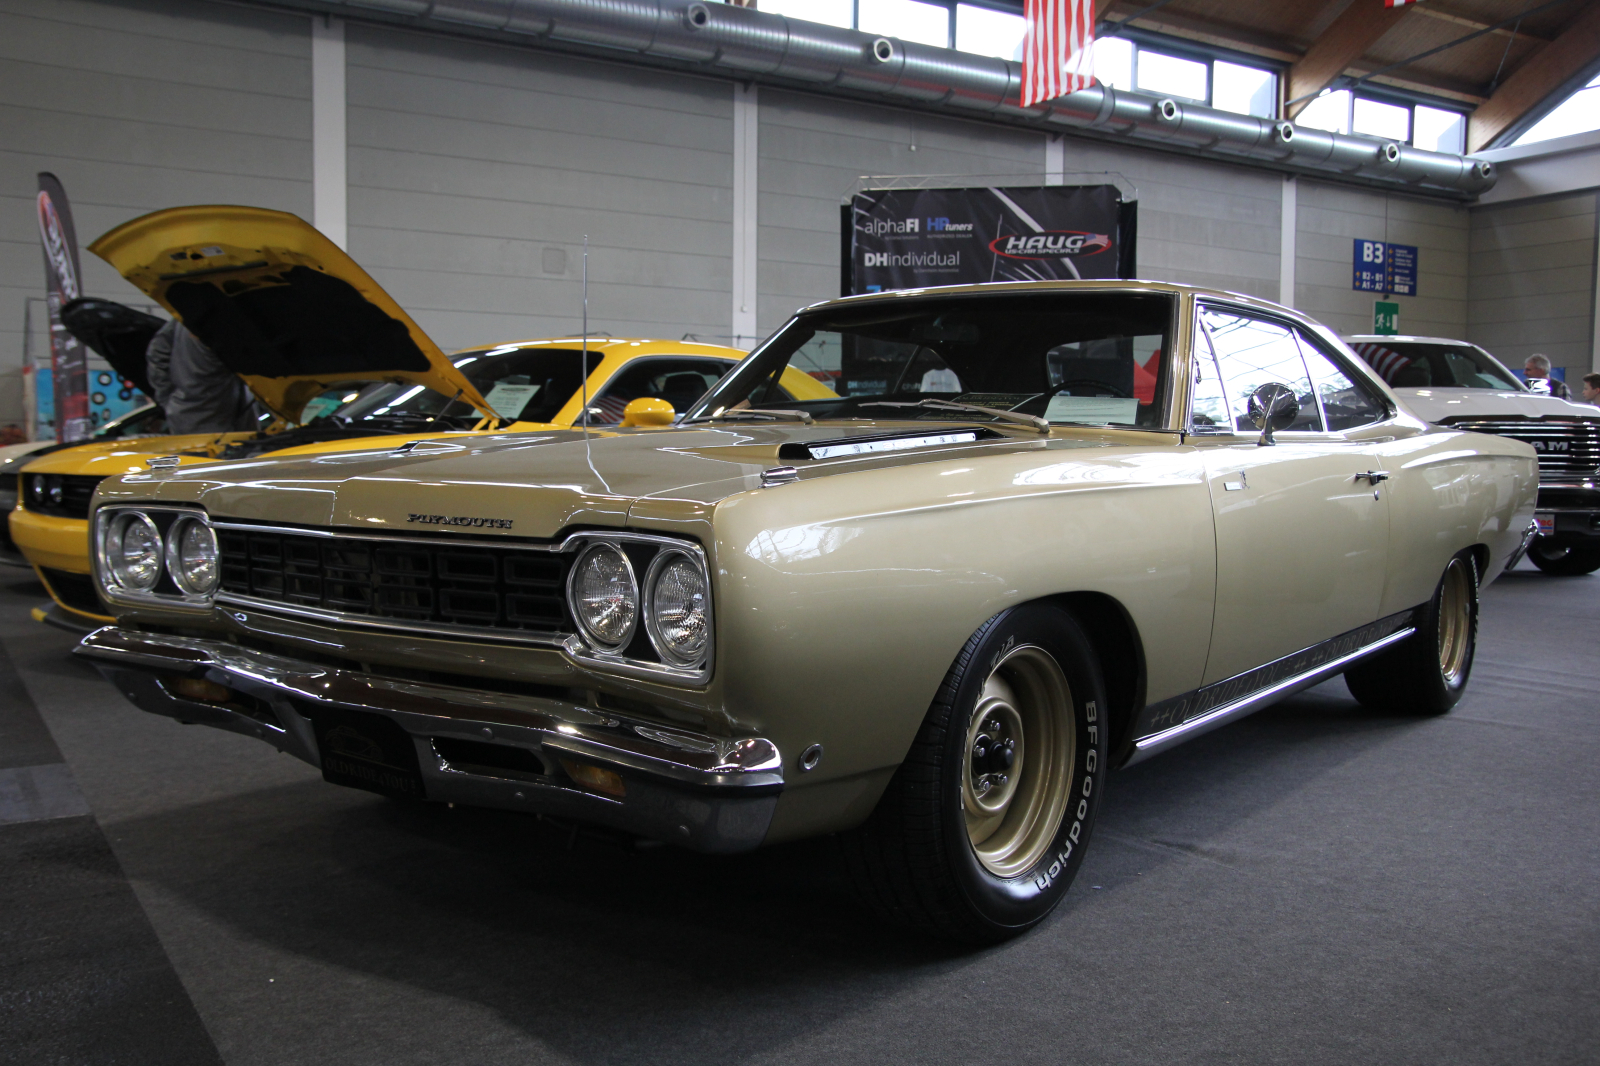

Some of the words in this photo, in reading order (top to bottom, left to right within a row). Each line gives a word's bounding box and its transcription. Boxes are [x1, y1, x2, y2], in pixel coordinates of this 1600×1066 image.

[1006, 235, 1085, 249] HAUG
[1363, 242, 1384, 263] B3
[1530, 441, 1568, 450] AM
[406, 513, 513, 529] PLYMOUTH
